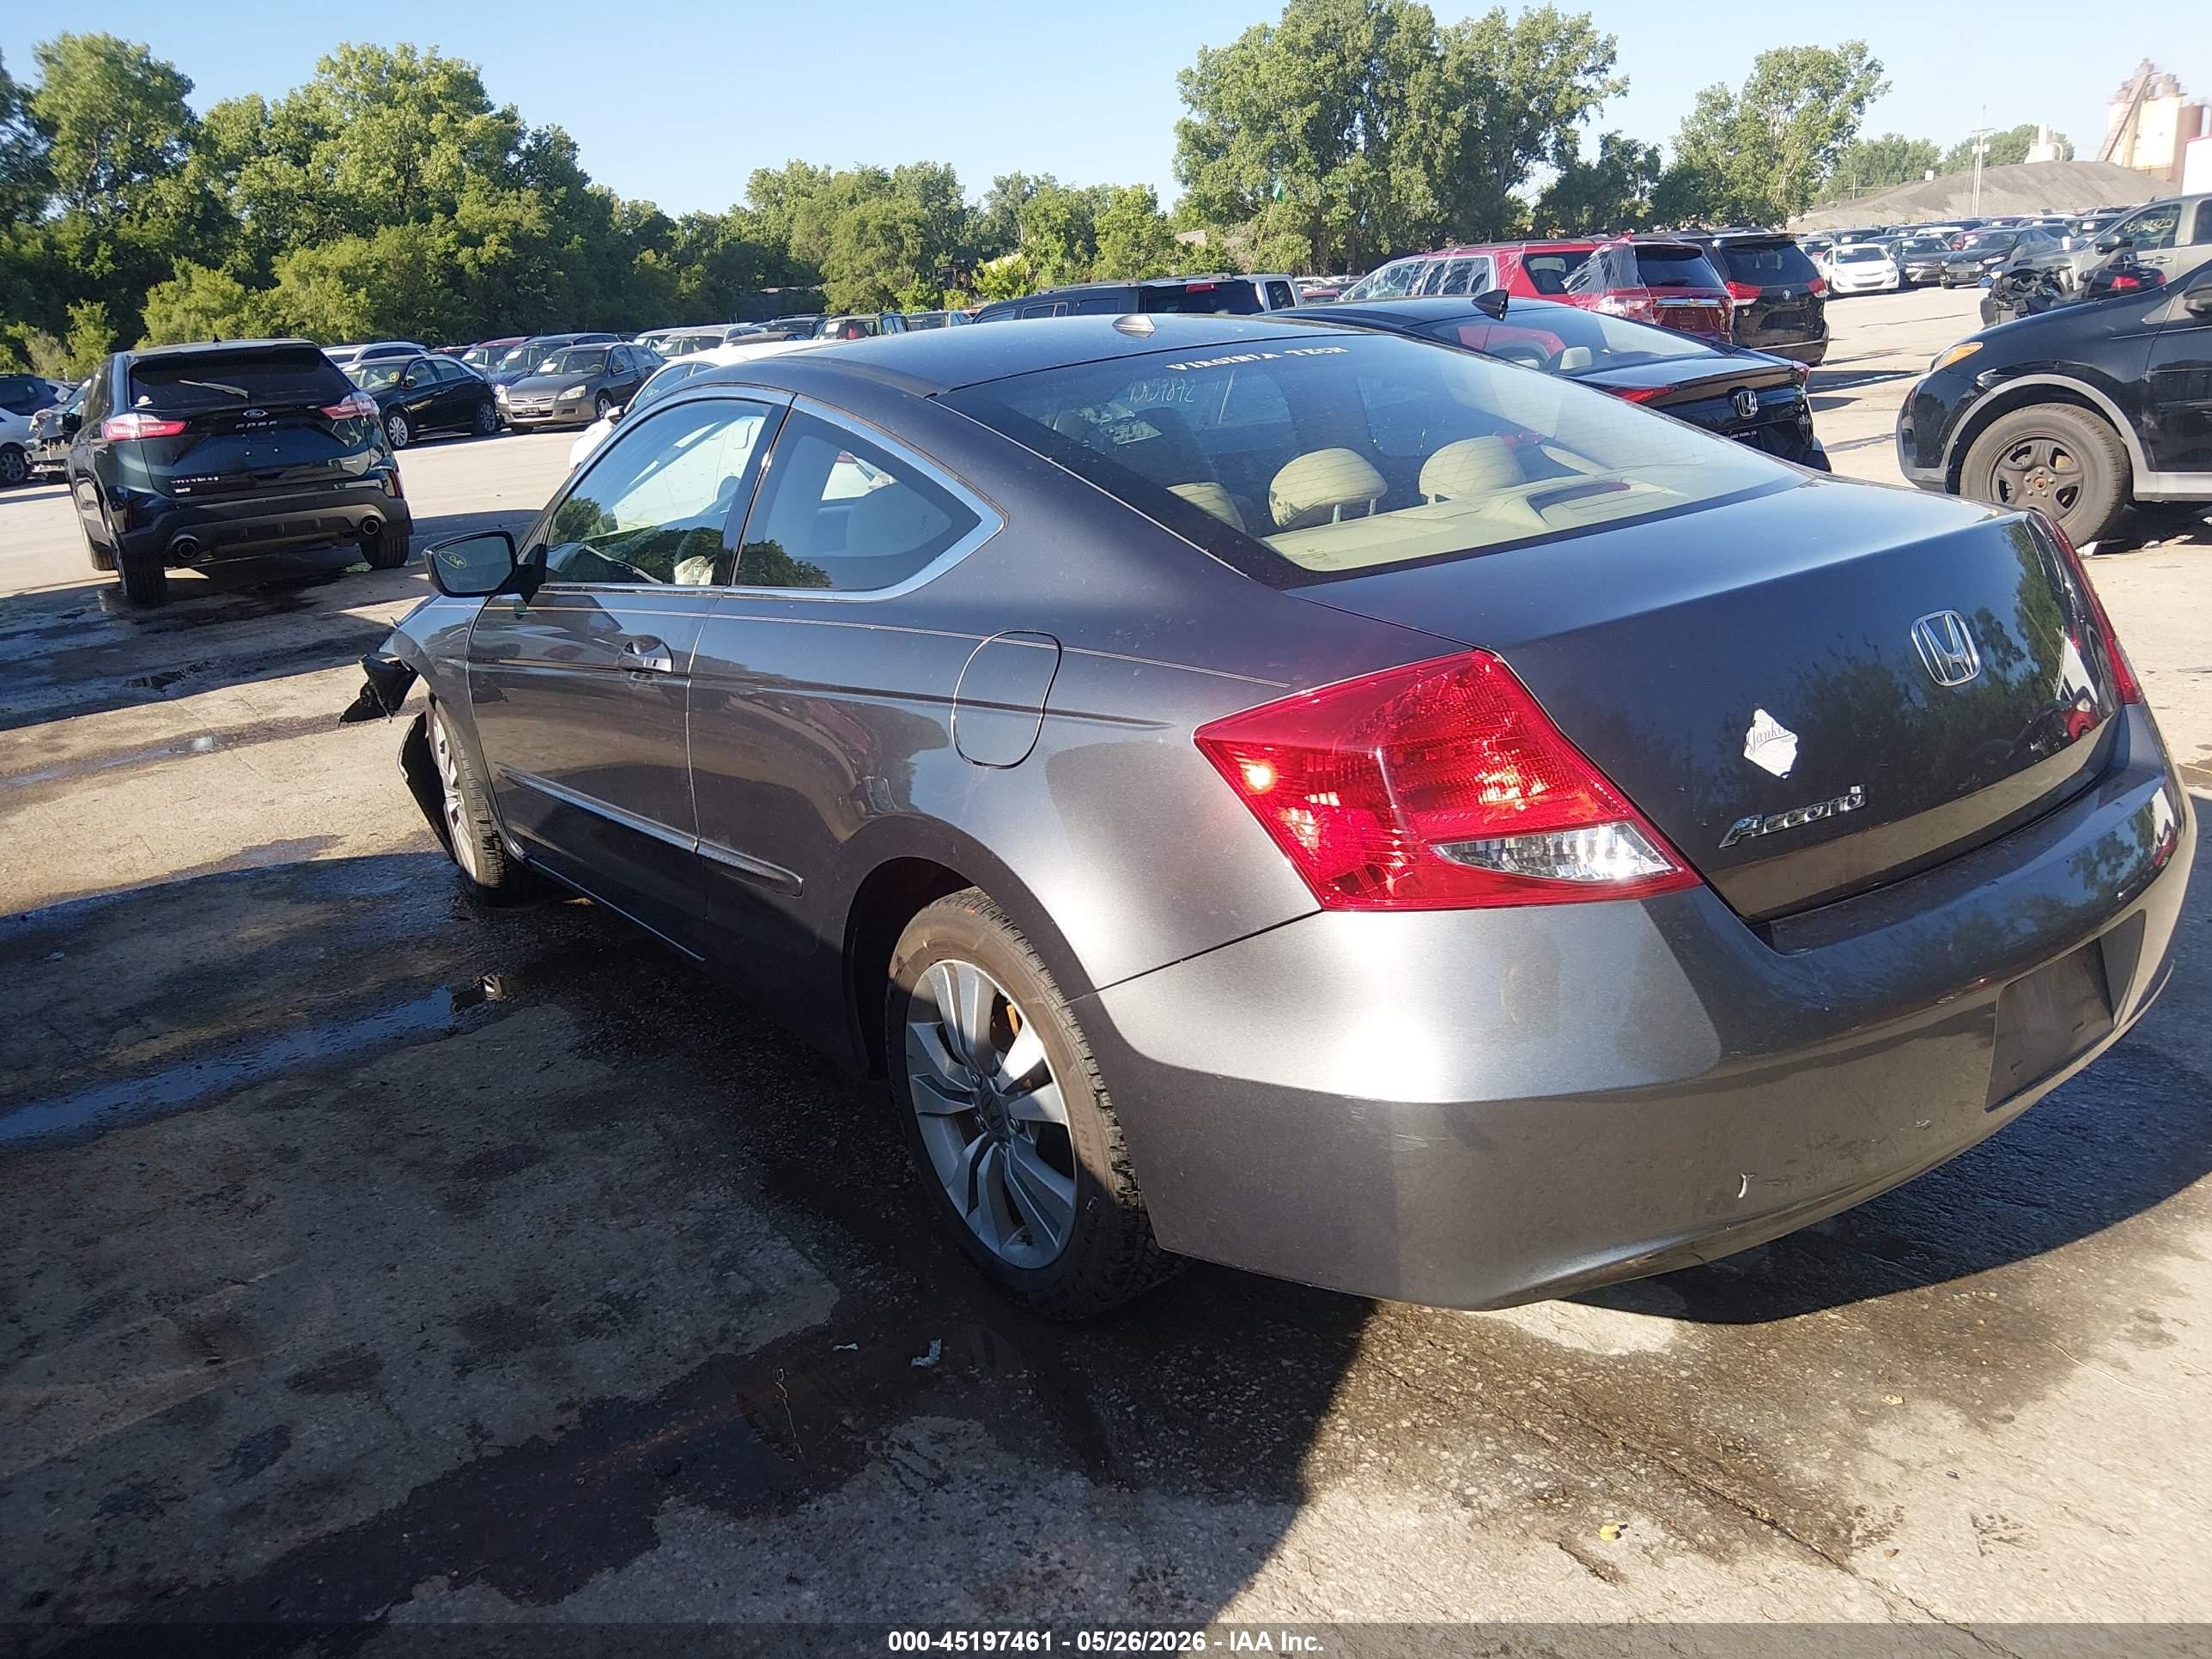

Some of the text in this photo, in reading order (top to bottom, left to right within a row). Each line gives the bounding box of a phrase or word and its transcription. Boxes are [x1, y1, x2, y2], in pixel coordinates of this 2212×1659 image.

[1164, 346, 1350, 371] VIRGINIA TECH
[1718, 784, 1867, 848] Accord
